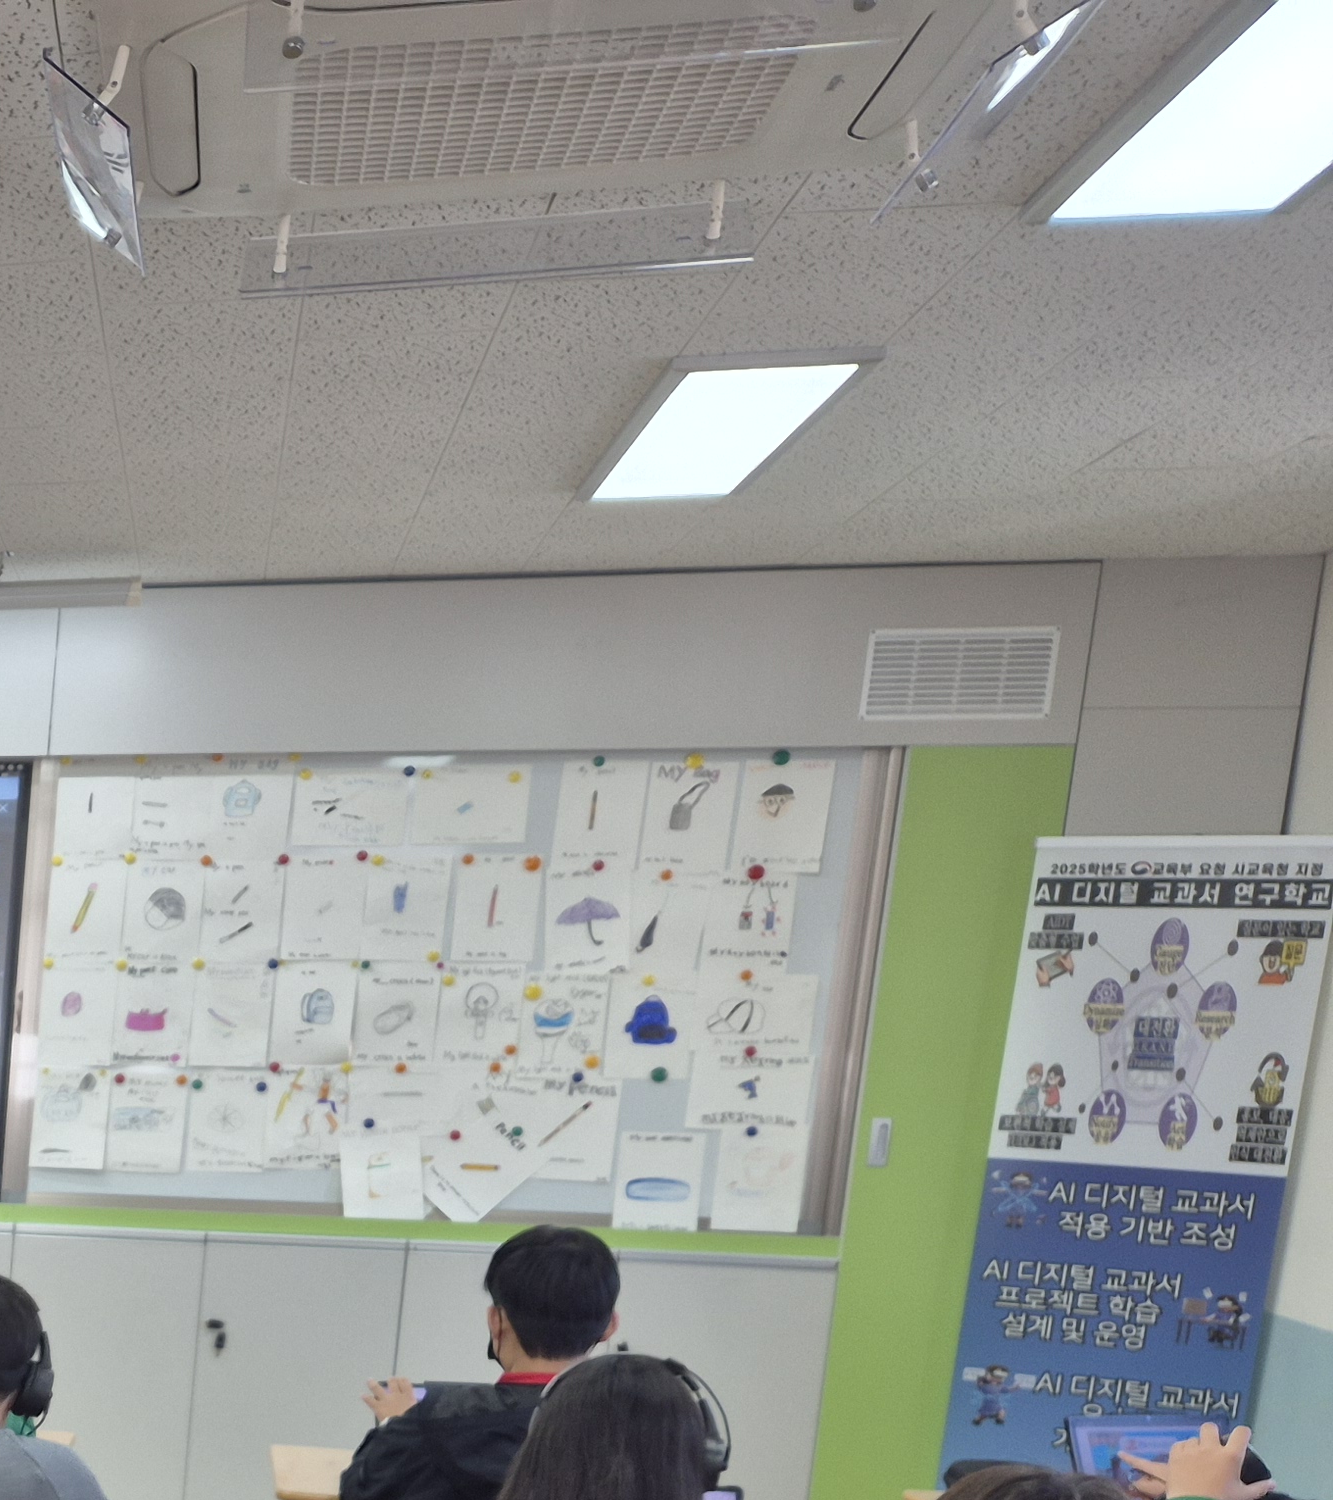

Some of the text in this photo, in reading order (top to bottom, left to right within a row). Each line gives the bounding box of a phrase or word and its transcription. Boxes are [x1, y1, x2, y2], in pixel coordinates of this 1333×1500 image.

[1050, 862, 1127, 877] 2025학년도
[1152, 862, 1193, 876] 교육부
[1232, 862, 1289, 877] 시교육청
[1295, 862, 1324, 877] 지정
[1035, 881, 1331, 906] AI 디지털 교과서 연구학교
[1048, 1181, 1256, 1221] AI 디지털 교과서
[1058, 1210, 1236, 1251] 적용 기반 조성
[983, 1259, 1182, 1299] AI 디지털 교과서
[994, 1285, 1162, 1326] 프로젝트 학습
[1001, 1311, 1147, 1351] 설계 및 운영
[1034, 1372, 1063, 1396] AI
[1070, 1374, 1151, 1410] 디지털
[1157, 1384, 1240, 1419] 교과서
